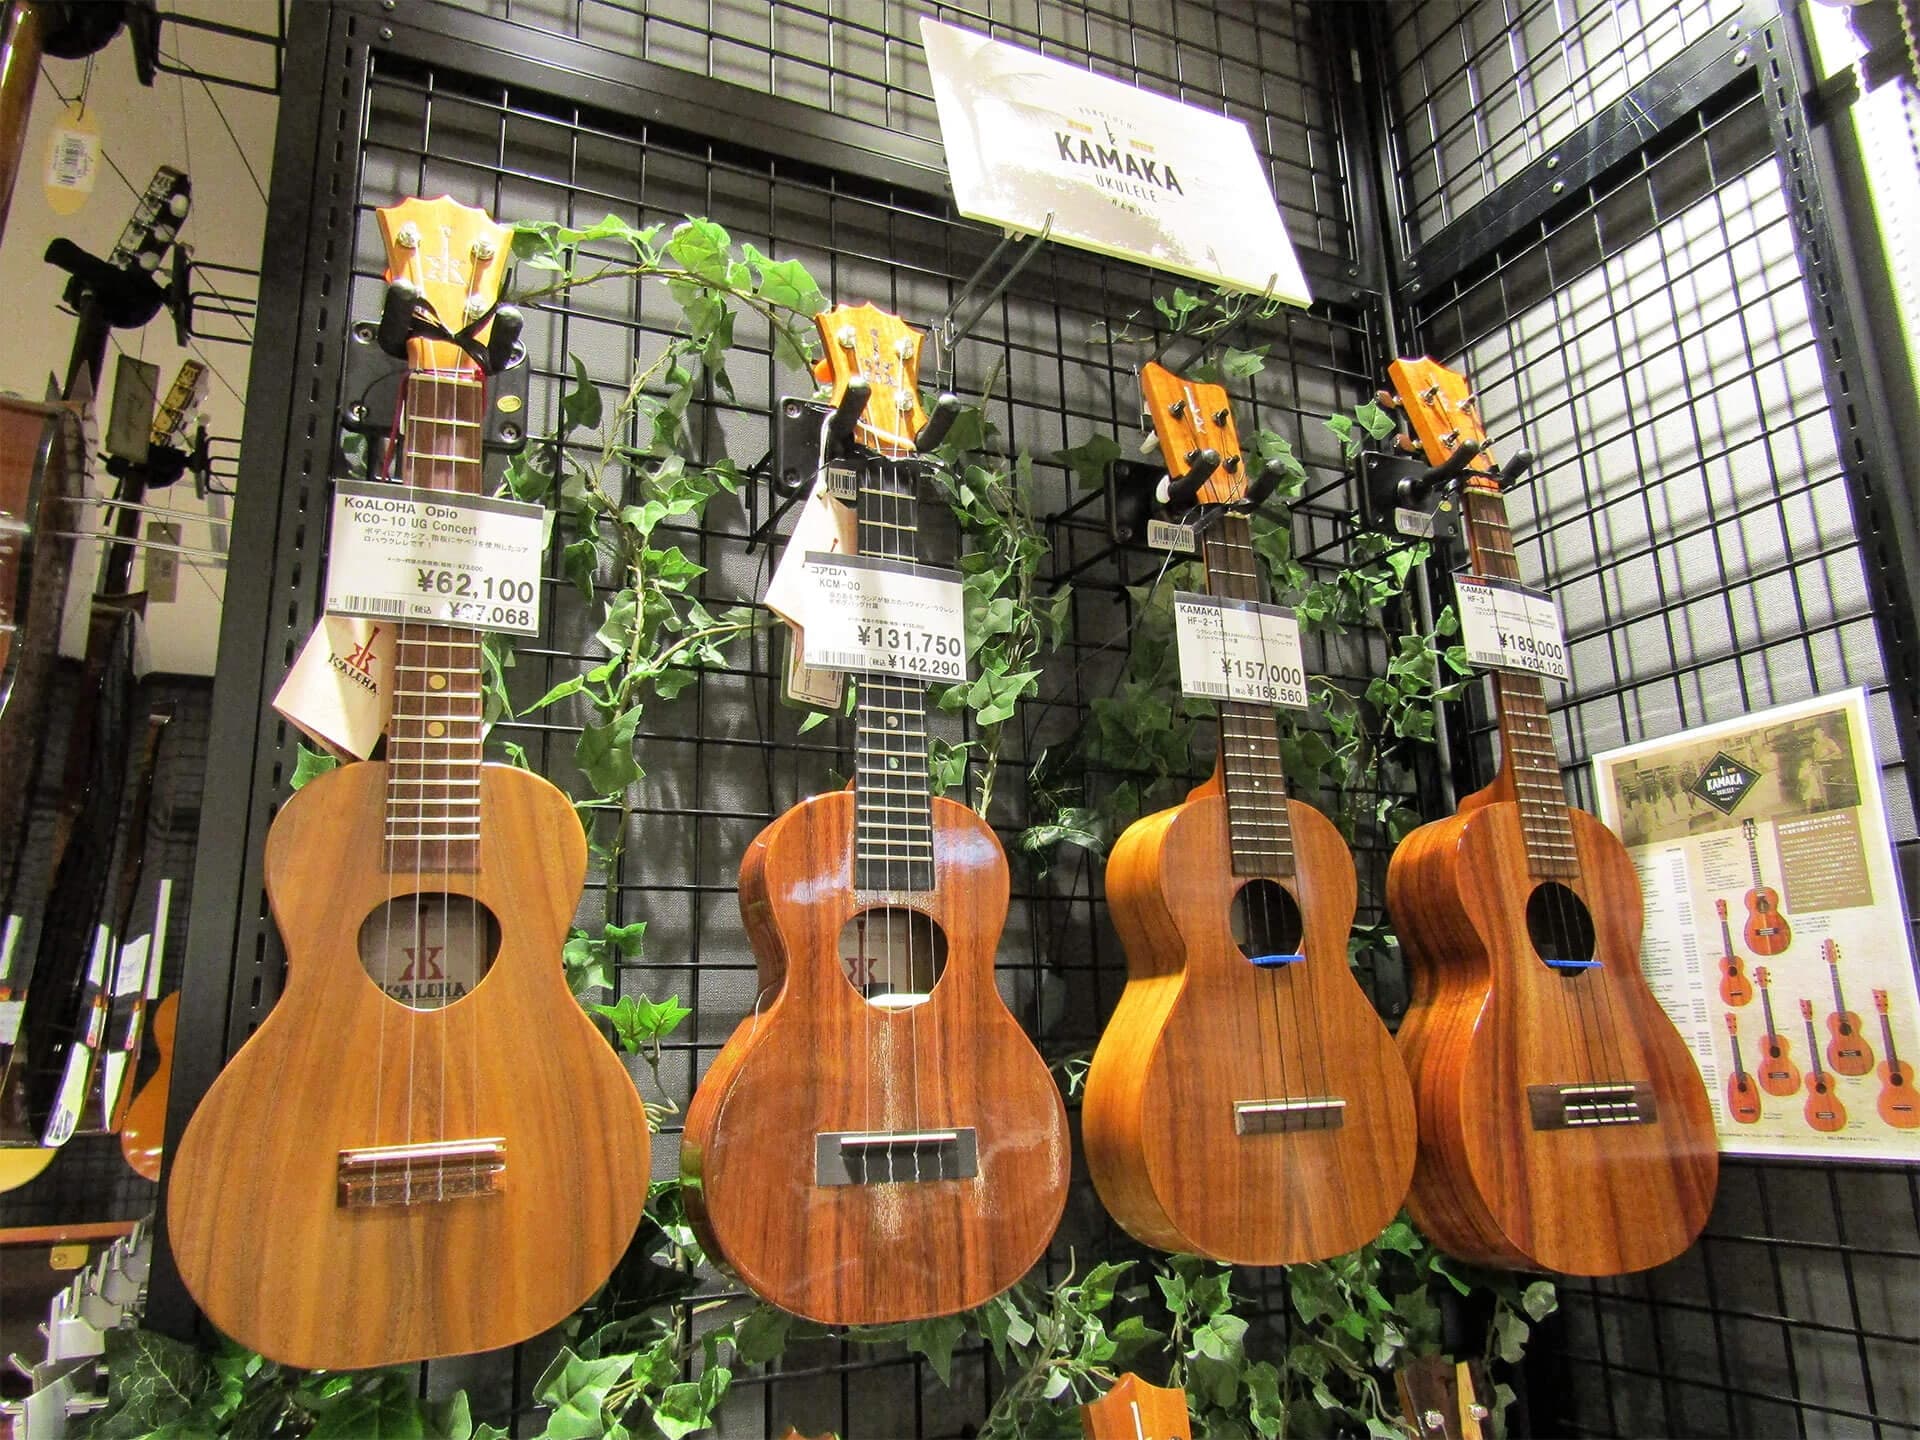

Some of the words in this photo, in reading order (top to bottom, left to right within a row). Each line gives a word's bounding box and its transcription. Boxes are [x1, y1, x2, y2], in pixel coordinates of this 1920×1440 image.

[1055, 131, 1184, 196] KAMAKA
[1095, 174, 1158, 203] UKULELE
[344, 497, 416, 515] KoALOHA
[425, 505, 458, 520] Opio
[354, 512, 406, 527] KCO-10
[411, 519, 428, 530] UG
[433, 520, 478, 536] Concert
[810, 566, 848, 576] コアロハ
[417, 568, 534, 604] ¥62,100
[819, 579, 861, 591] KCM-00
[1460, 585, 1494, 597] KAMAKA
[1180, 604, 1220, 617] KAMAKA
[857, 625, 961, 657] ¥131,750
[1499, 632, 1562, 660] ¥189,000
[1706, 773, 1743, 792] KAMAKA
